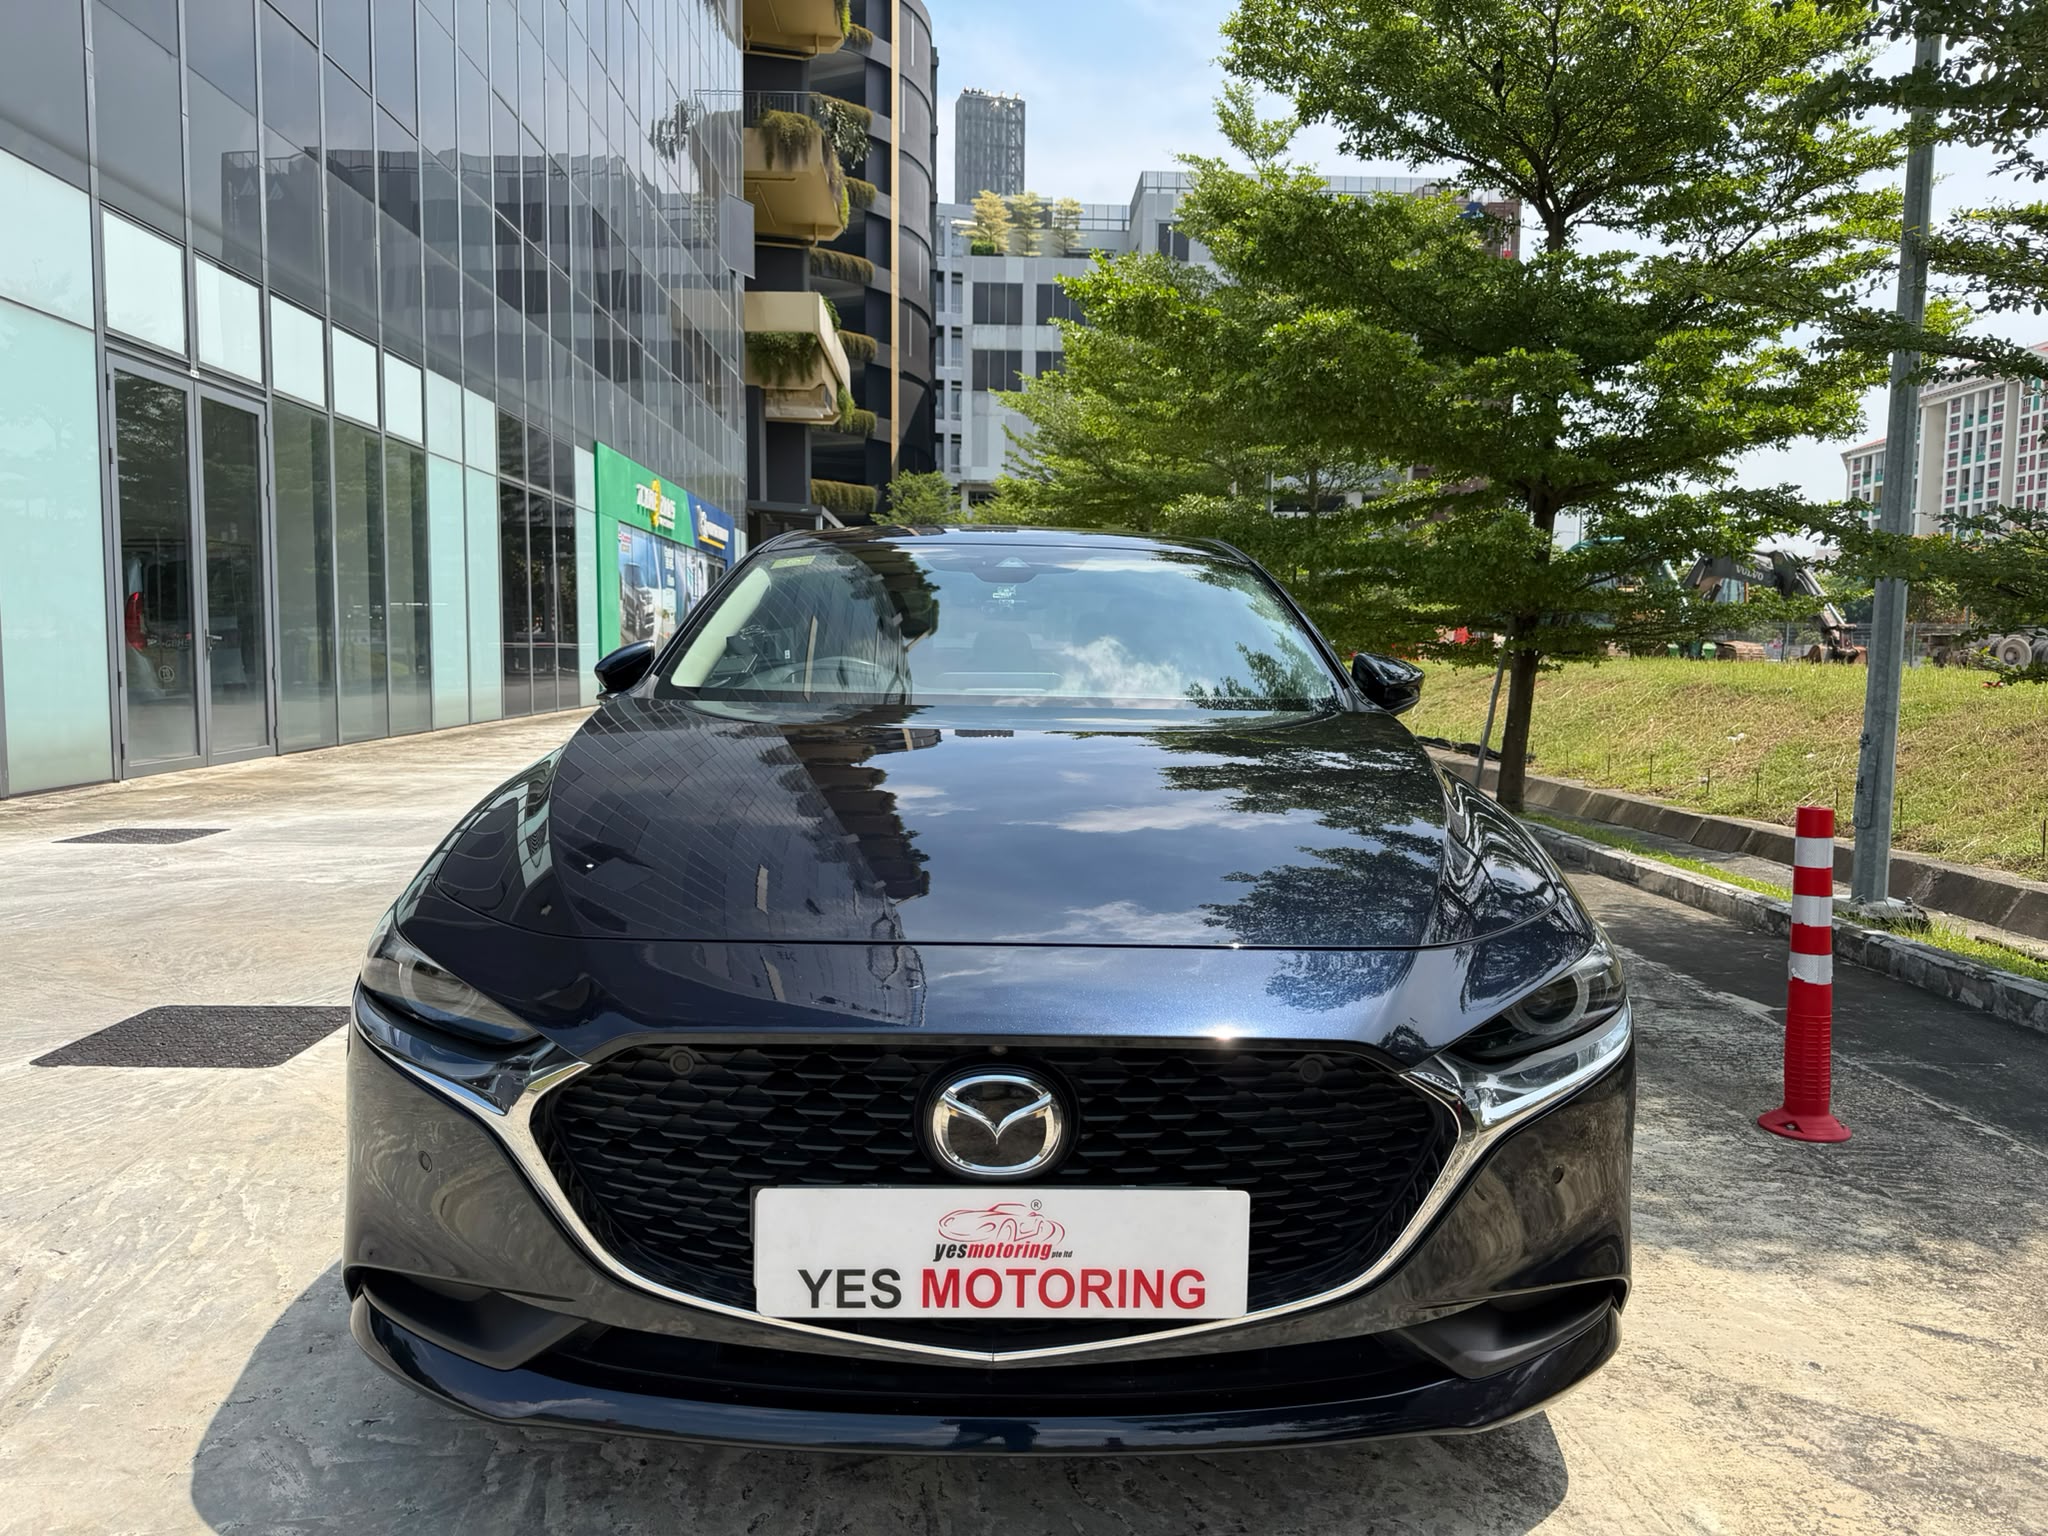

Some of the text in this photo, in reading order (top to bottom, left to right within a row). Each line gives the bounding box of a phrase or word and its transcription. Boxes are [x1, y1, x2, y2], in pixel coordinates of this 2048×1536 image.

[933, 1242, 1073, 1262] yesmotoring pte ltd
[798, 1269, 1207, 1308] YES MOTORING
